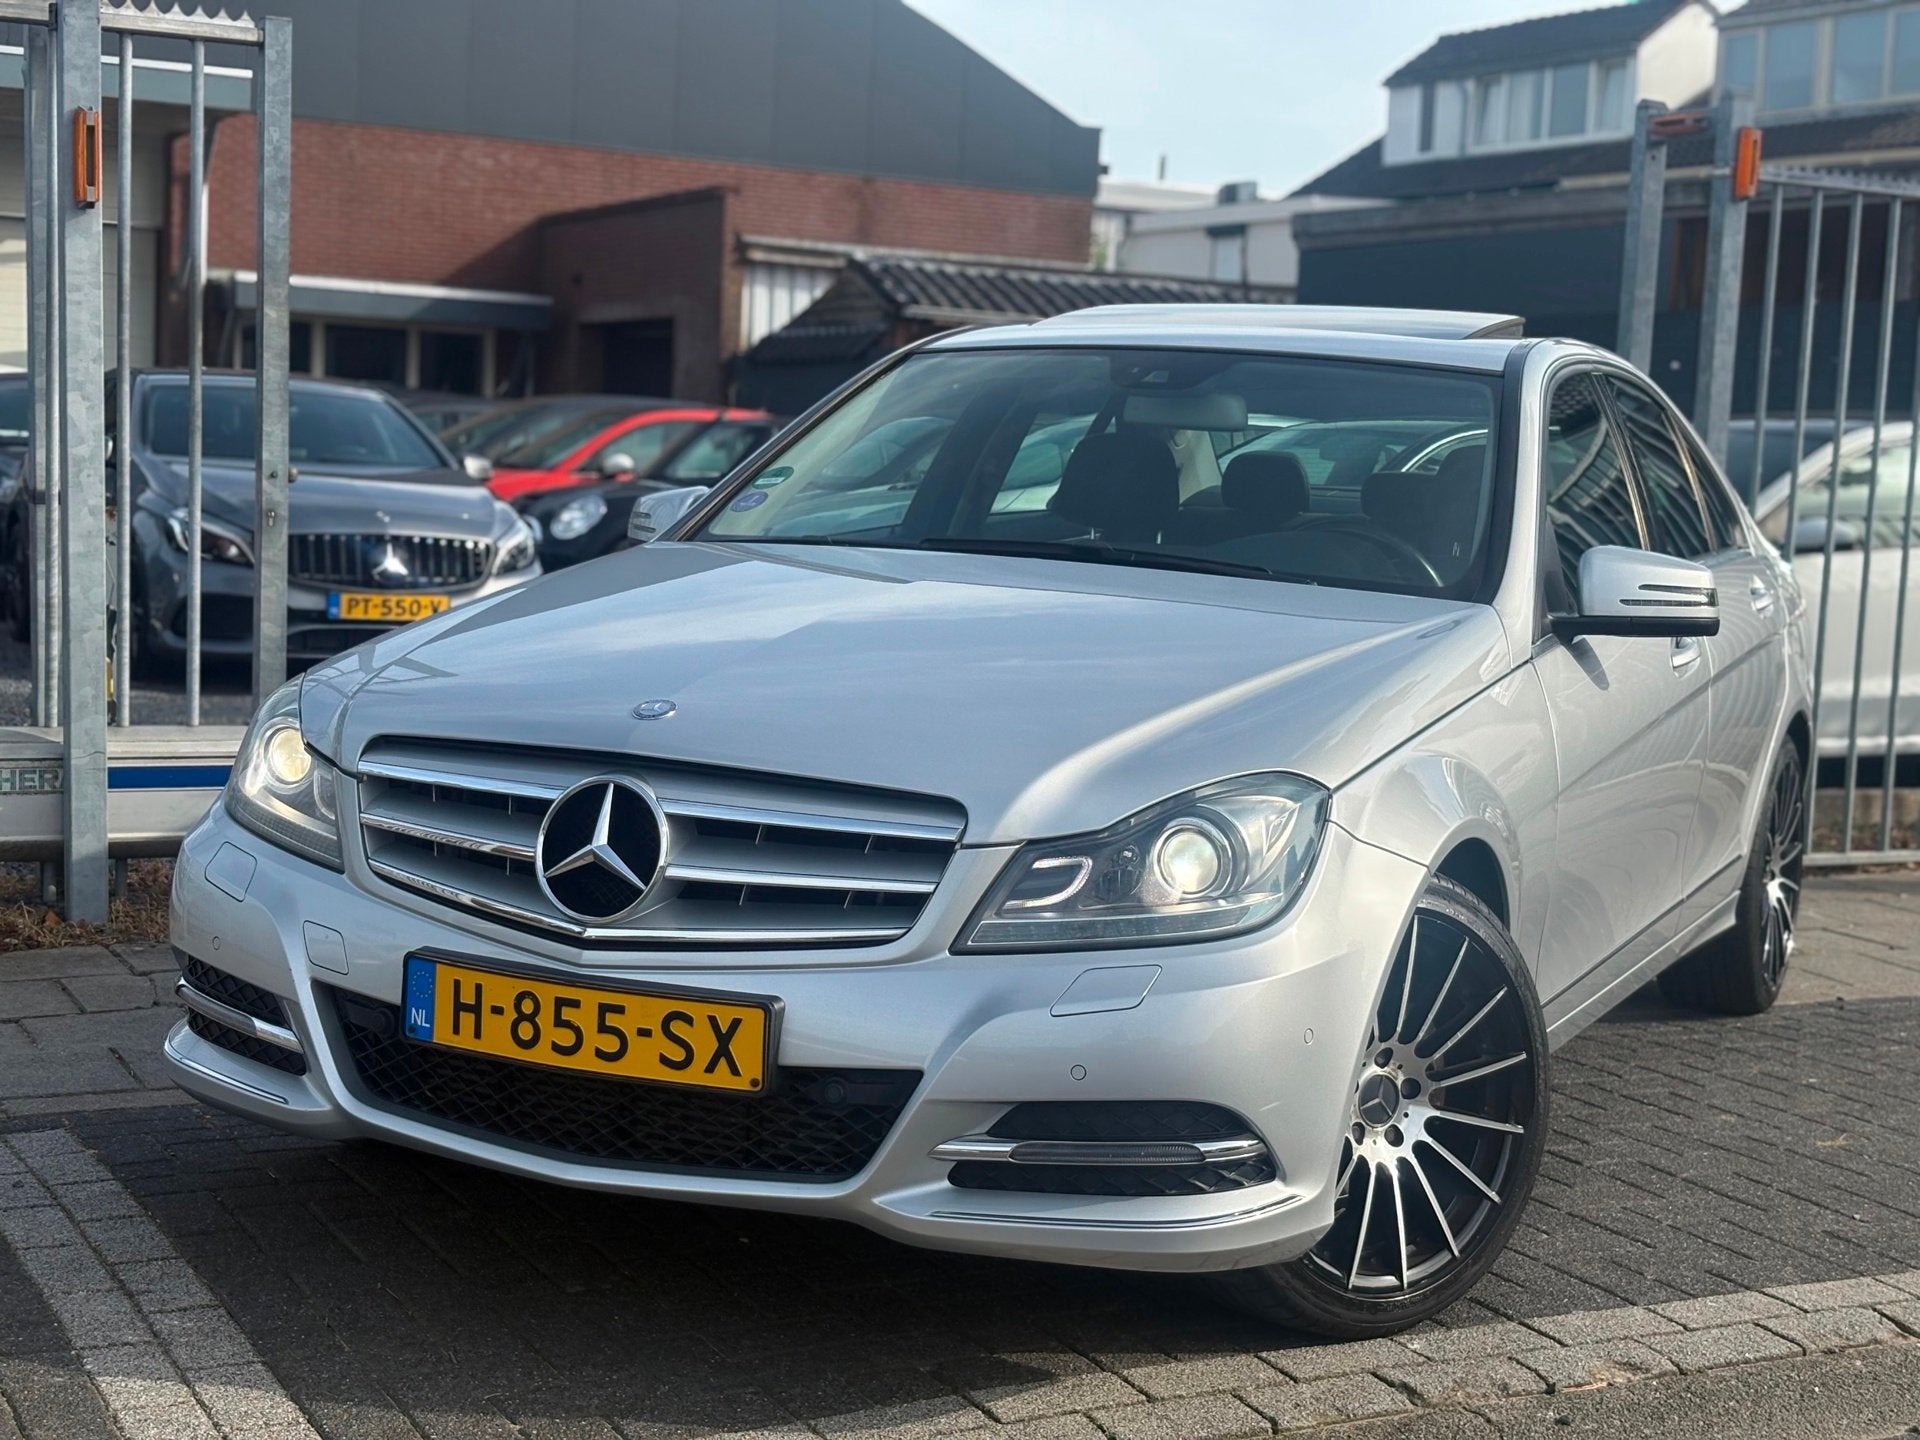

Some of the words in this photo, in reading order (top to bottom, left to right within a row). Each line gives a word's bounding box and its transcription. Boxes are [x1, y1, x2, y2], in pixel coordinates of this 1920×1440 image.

[0, 769, 63, 790] HER
[411, 1007, 431, 1027] NL
[452, 978, 743, 1077] H-855-SX
